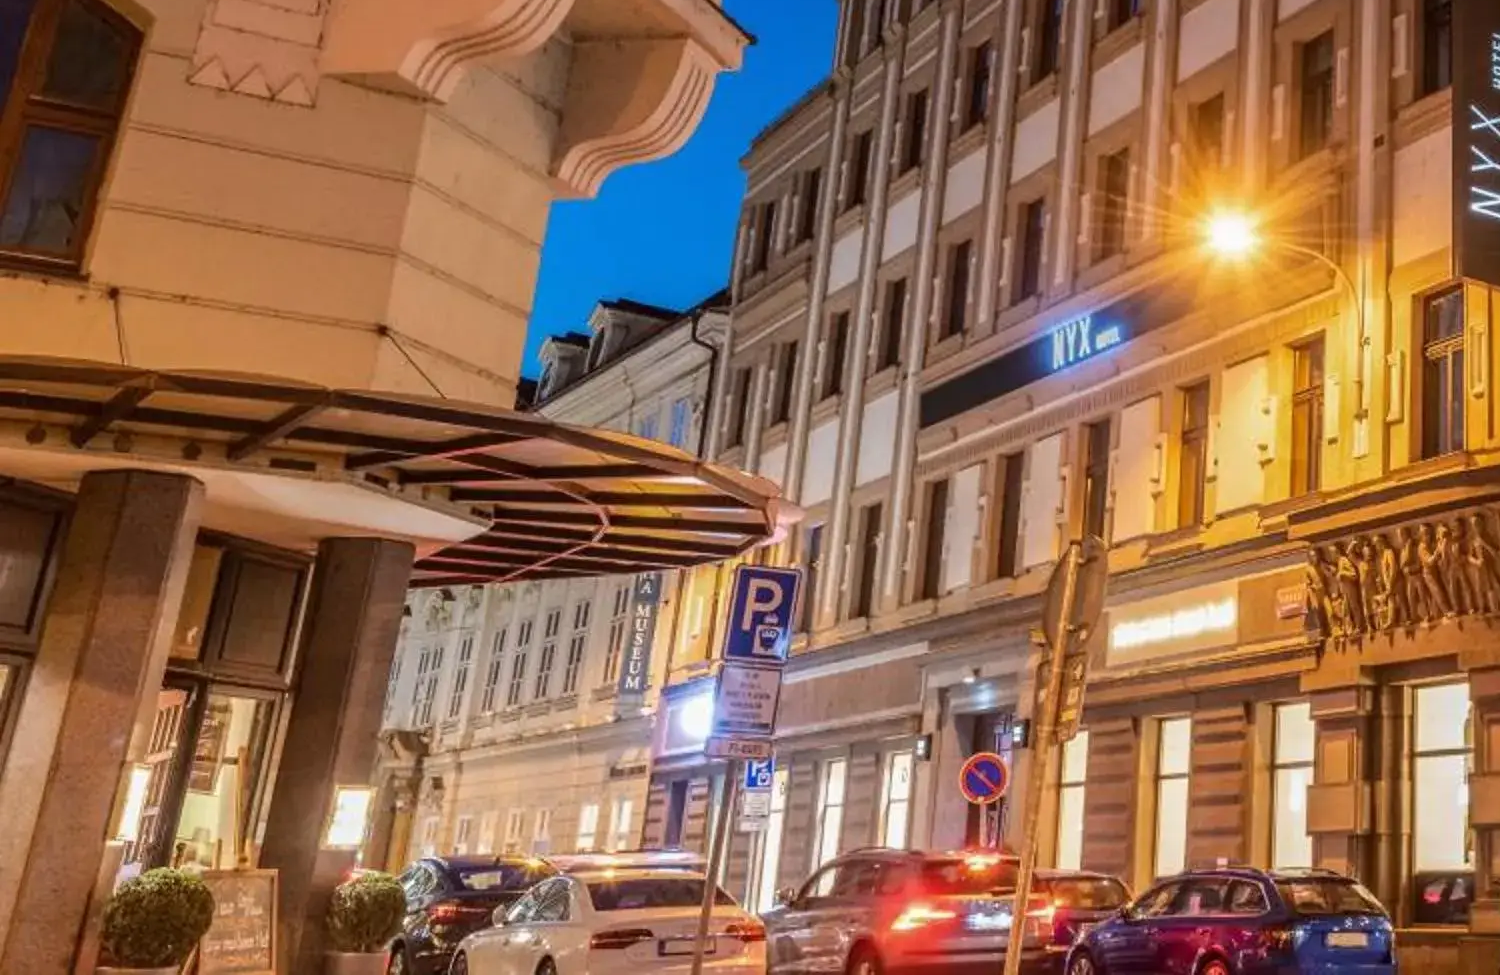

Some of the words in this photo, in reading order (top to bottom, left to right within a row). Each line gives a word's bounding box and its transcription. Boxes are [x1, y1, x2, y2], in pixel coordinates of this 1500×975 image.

[1052, 316, 1091, 370] NYX
[741, 577, 785, 631] P
[624, 604, 651, 690] MUSEUM
